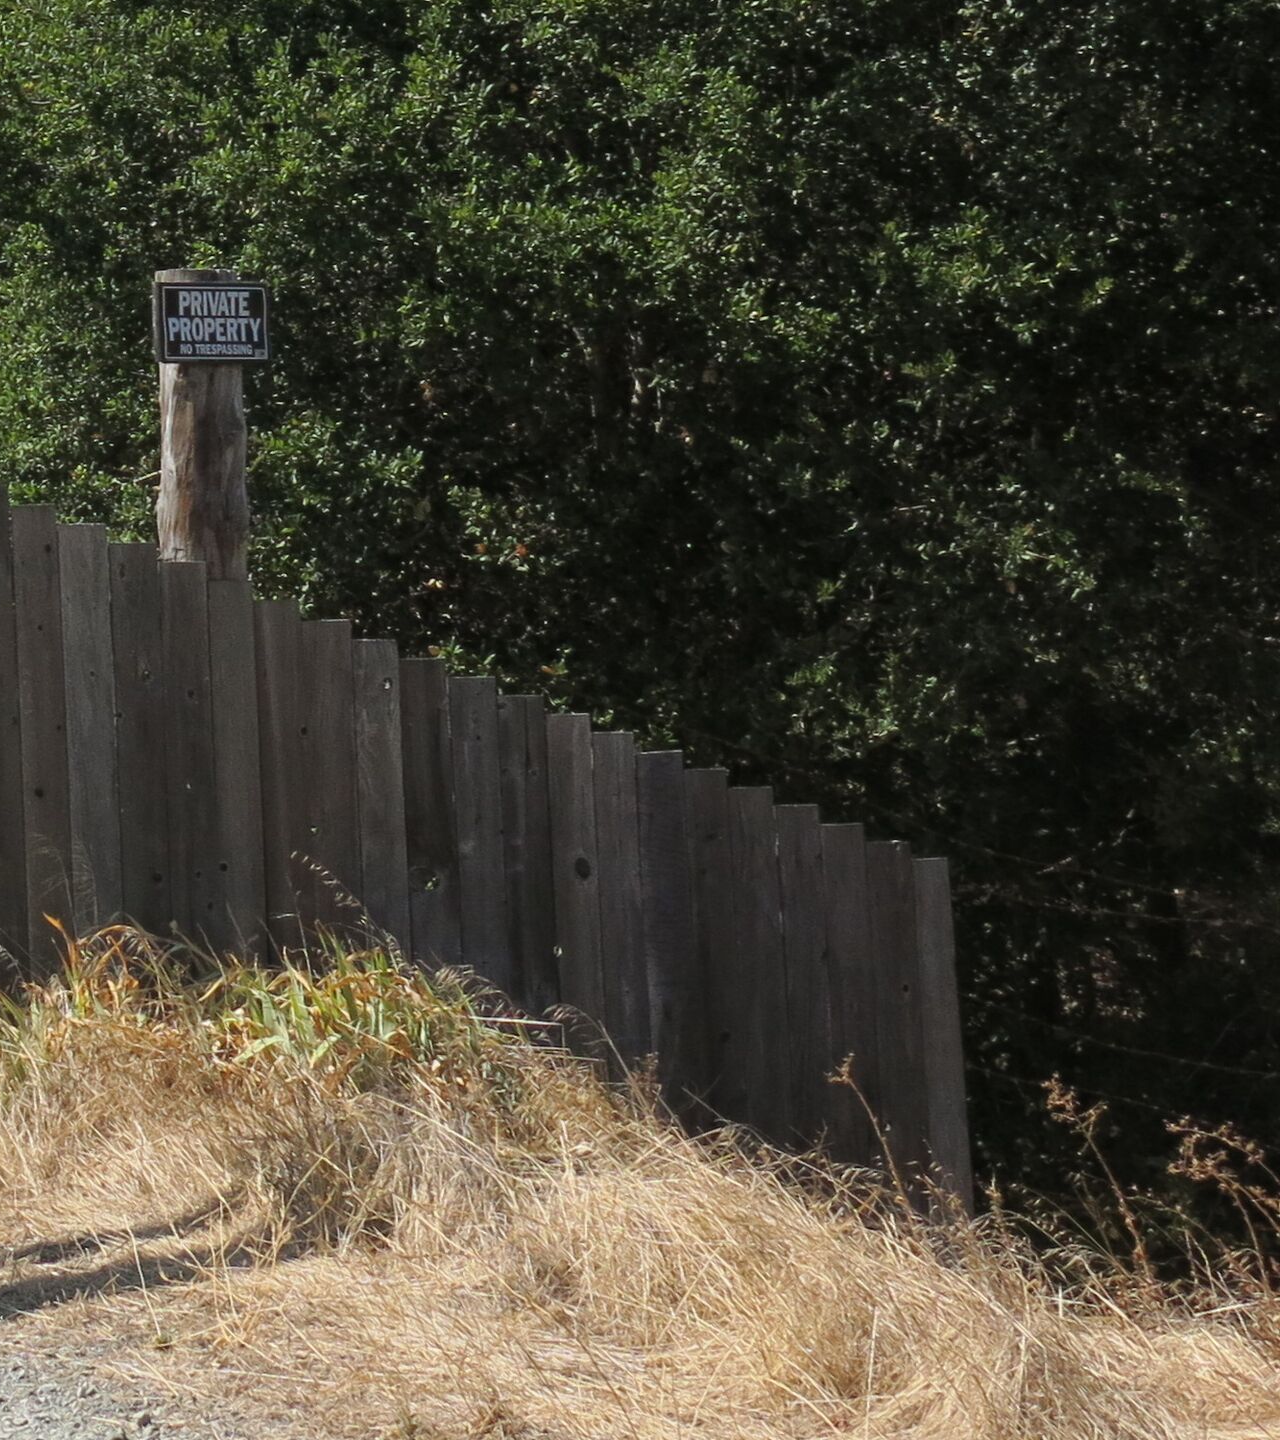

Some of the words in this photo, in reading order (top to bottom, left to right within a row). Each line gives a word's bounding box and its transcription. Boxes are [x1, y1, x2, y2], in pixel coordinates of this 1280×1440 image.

[178, 291, 250, 317] PRIVATE
[167, 317, 261, 342] PROPERTY
[179, 344, 193, 355] NO
[195, 344, 253, 355] TRESPASSING
